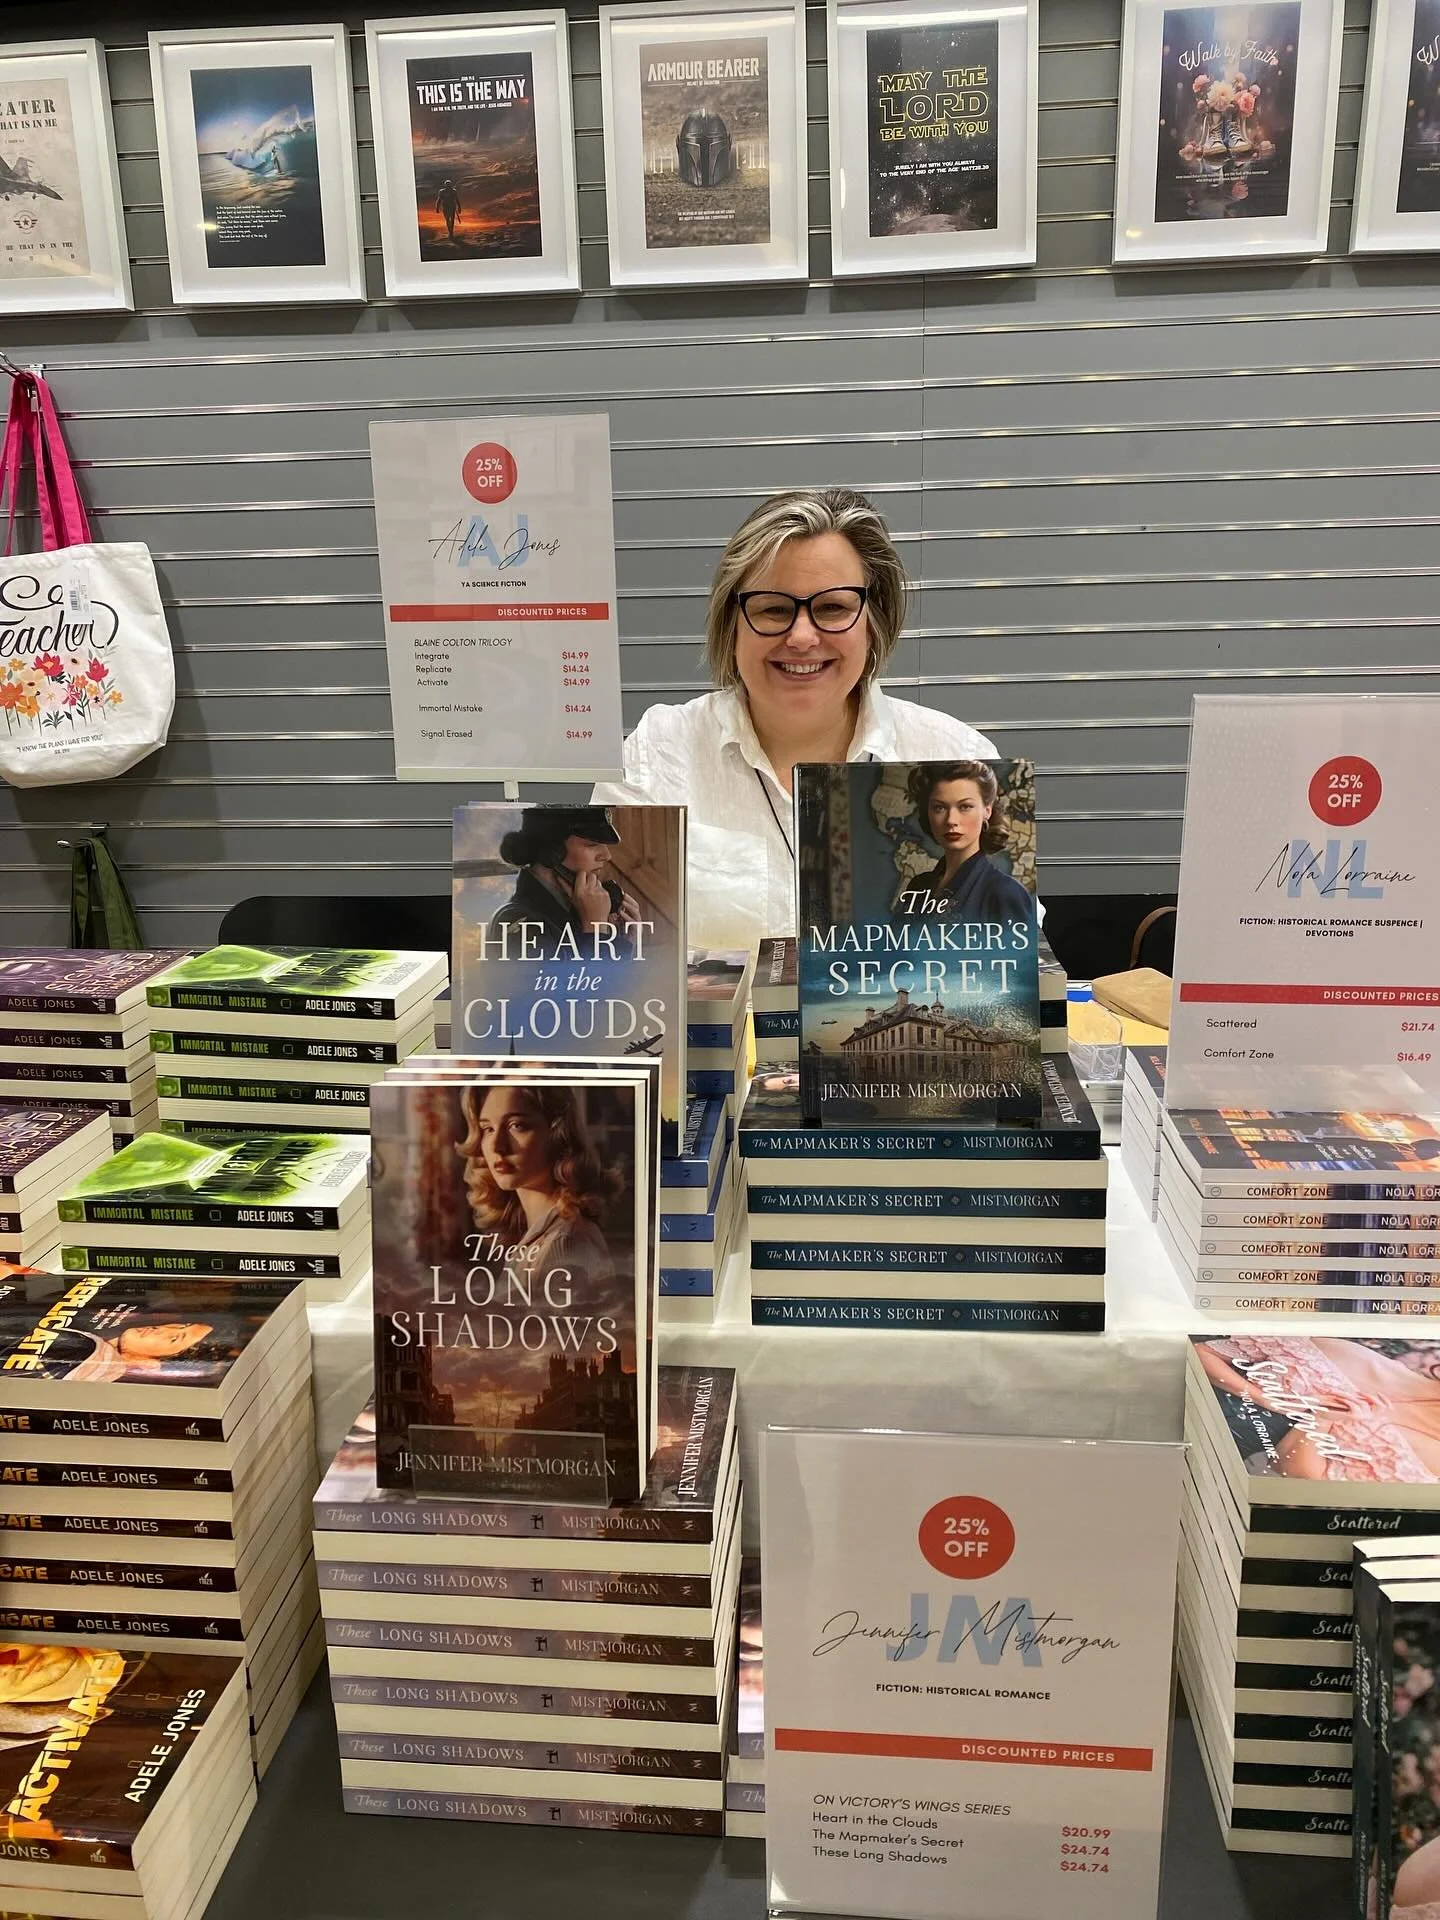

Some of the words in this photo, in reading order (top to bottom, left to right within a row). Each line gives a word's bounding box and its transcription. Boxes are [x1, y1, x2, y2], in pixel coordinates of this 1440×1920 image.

[1179, 42, 1221, 71] Walk
[1242, 40, 1279, 66] Faith
[648, 62, 703, 81] ARMOUR
[707, 57, 759, 79] BEARER
[878, 71, 932, 93] MAY
[943, 67, 988, 88] THE
[417, 85, 446, 104] THIS
[450, 83, 462, 102] IS
[466, 81, 492, 101] THE
[496, 79, 525, 99] WAY
[0, 99, 56, 116] ATER
[880, 91, 988, 124] LORD
[22, 120, 30, 129] IS
[33, 119, 42, 128] IN
[45, 119, 57, 127] ME
[880, 128, 905, 141] BE
[910, 124, 948, 138] WITH
[954, 121, 989, 135] YOU
[475, 458, 503, 471] 25%
[477, 476, 503, 488] OFF
[428, 519, 489, 563] Adele
[498, 528, 560, 570] Jones
[497, 608, 554, 616] DISCOUNTED
[556, 608, 587, 616] PRICES
[0, 610, 105, 657] eacher
[415, 652, 449, 662] Integrate
[562, 651, 589, 660] $14.99
[416, 665, 452, 674] Replicate
[563, 665, 589, 673] $14.24
[563, 678, 590, 686] $14.99
[419, 704, 452, 713] Immortal
[454, 704, 483, 713] Mistake
[565, 704, 591, 713] $14.24
[421, 730, 445, 739] Signal
[447, 730, 472, 738] Erased
[566, 730, 593, 739] $14.99
[1328, 775, 1363, 789] 25%
[1328, 794, 1361, 808] OFF
[1255, 843, 1323, 892] Nola
[1320, 847, 1415, 895] Lorraine
[900, 889, 948, 914] The
[1278, 918, 1327, 926] HISTORICAL
[1330, 919, 1372, 927] ROMANCE
[1375, 919, 1416, 927] SUSPENCE
[476, 921, 654, 961] HEART
[810, 920, 1029, 953] MAPMAKER'S
[534, 969, 558, 991] in
[566, 967, 602, 991] the
[828, 959, 1017, 996] SECRET
[8, 998, 38, 1007] ADELE
[44, 1000, 76, 1009] JONES
[177, 994, 223, 1006] IMMORTAL
[228, 996, 267, 1008] MISTAKE
[305, 1000, 331, 1011] ADELE
[332, 1000, 356, 1012] JONES
[1324, 991, 1396, 1000] DISCOUNTED
[1399, 992, 1439, 1001] PRICES
[464, 998, 666, 1039] CLOUDS
[1206, 1019, 1257, 1029] Scattered
[1401, 1022, 1435, 1032] $21.74
[1204, 1049, 1245, 1058] Comfort
[1249, 1050, 1274, 1059] Zone
[1397, 1052, 1431, 1062] $16.49
[821, 1084, 901, 1102] JENNIFER
[908, 1083, 1022, 1098] MISTMORGAN
[752, 1138, 768, 1148] The
[770, 1136, 871, 1149] MAPMAKER'S
[877, 1137, 935, 1150] SECRET
[962, 1136, 1054, 1149] MISTMORGAN
[1247, 1187, 1298, 1196] COMFORT
[1304, 1187, 1333, 1196] ZONE
[1385, 1188, 1415, 1197] NOLA
[464, 1233, 540, 1262] These
[430, 1266, 572, 1308] LONG
[2, 1277, 112, 1371] REPLICATE
[391, 1311, 618, 1353] SHADOWS
[688, 1377, 713, 1440] MISTMORGAN
[1232, 1358, 1372, 1461] Scattered
[53, 1419, 99, 1432] ADELE
[103, 1421, 150, 1434] JONES
[1251, 1414, 1280, 1461] LORRAINE
[395, 1451, 483, 1472] JENNIFER
[491, 1458, 617, 1477] MISTMORGAN
[678, 1442, 702, 1497] JENNIFER
[325, 1508, 363, 1523] These
[371, 1511, 417, 1525] LONG
[422, 1512, 508, 1527] SHADOWS
[561, 1516, 661, 1531] MISTMORGAN
[943, 1517, 989, 1536] 25%
[1327, 1515, 1401, 1530] Scattered
[944, 1541, 989, 1558] OFF
[812, 1610, 941, 1661] Jennifer
[954, 1600, 1120, 1664] Mistmorgan
[876, 1684, 923, 1694] FICTION:
[926, 1687, 991, 1697] HISTORICAL
[994, 1690, 1051, 1700] ROMANCE
[124, 1745, 173, 1803] ADELE
[163, 1689, 206, 1742] JONES
[961, 1744, 1057, 1759] DISCOUNTED
[1062, 1750, 1115, 1763] PRICES
[813, 1794, 835, 1805] ON
[838, 1796, 911, 1811] VICTORY'S
[914, 1800, 960, 1813] WINGS
[963, 1803, 1012, 1816] SERIES
[812, 1812, 848, 1824] Heart
[852, 1815, 863, 1825] in
[867, 1815, 888, 1826] the
[892, 1817, 938, 1829] Clouds
[1061, 1826, 1111, 1839] $20.99
[812, 1830, 835, 1841] The
[838, 1831, 917, 1846] Mapmaker's
[920, 1835, 964, 1848] Secret
[1060, 1843, 1110, 1857] $24.74
[813, 1847, 850, 1858] These
[853, 1849, 884, 1863] Long
[888, 1852, 948, 1865] Shadows
[1060, 1861, 1109, 1873] $24.74
